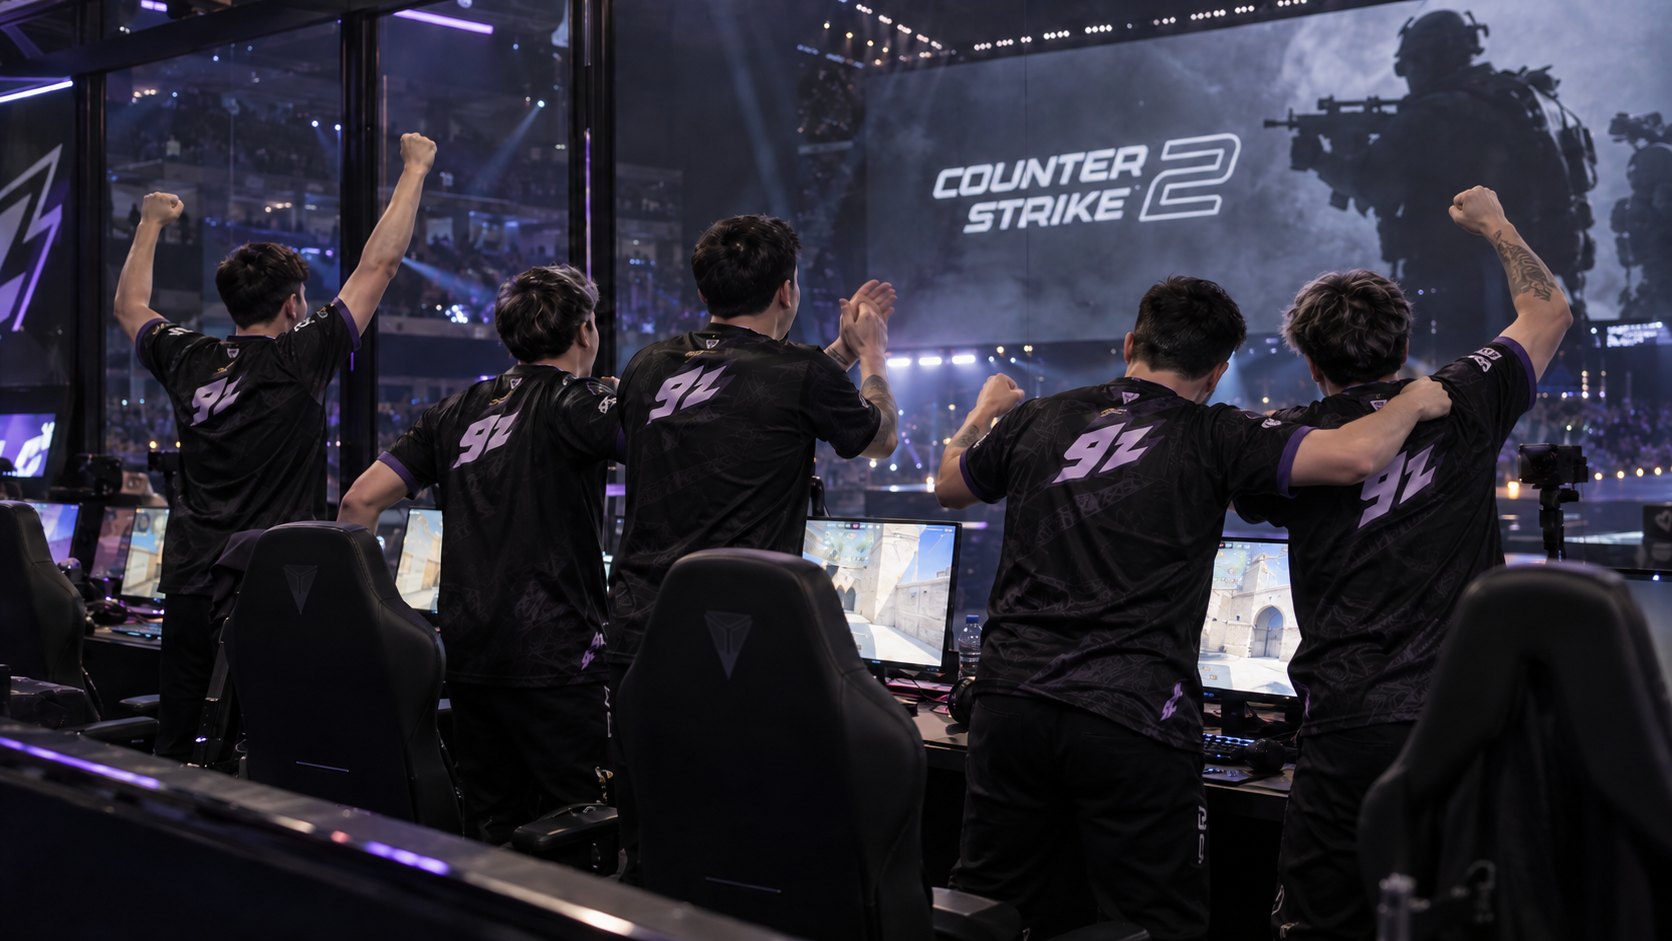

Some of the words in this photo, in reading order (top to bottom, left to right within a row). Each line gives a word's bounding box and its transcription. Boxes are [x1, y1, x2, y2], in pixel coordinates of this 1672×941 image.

[933, 145, 1149, 199] COUNTER
[1138, 132, 1242, 222] 2
[963, 187, 1131, 234] STRIKE
